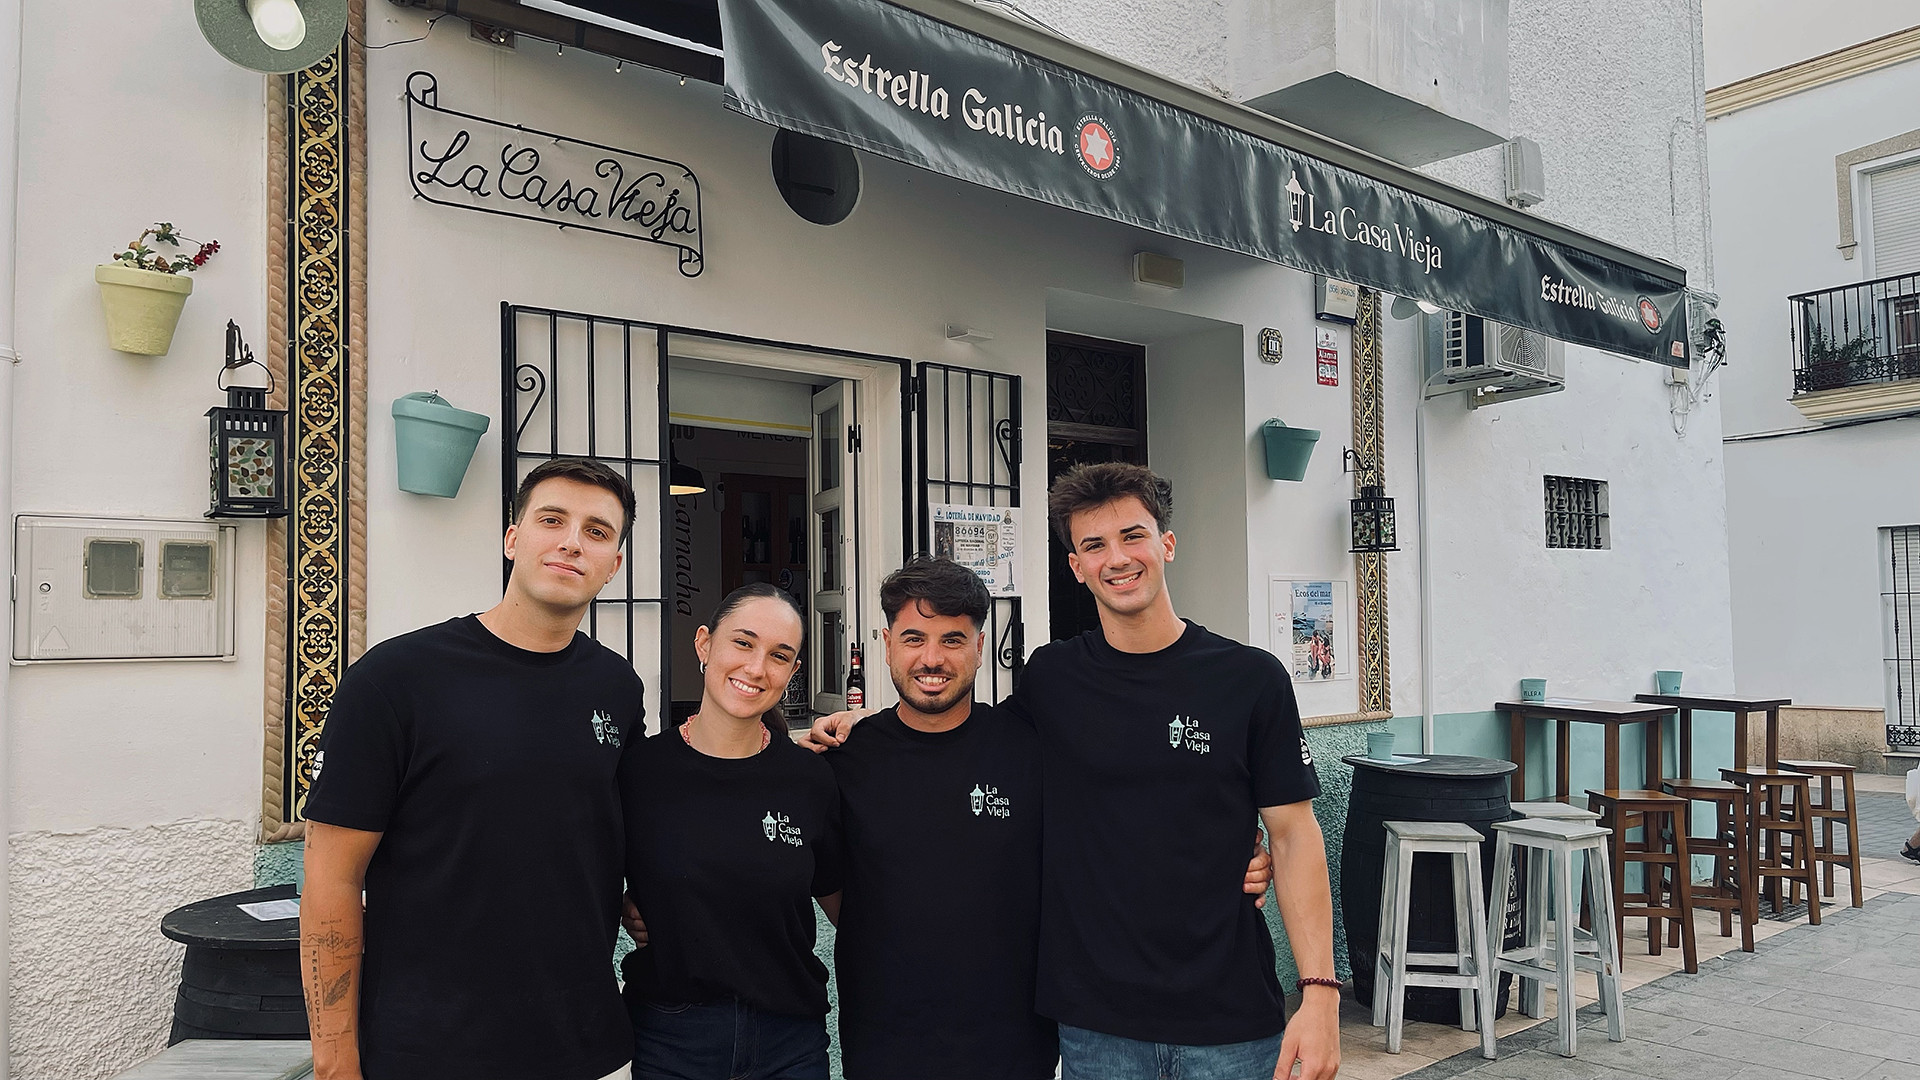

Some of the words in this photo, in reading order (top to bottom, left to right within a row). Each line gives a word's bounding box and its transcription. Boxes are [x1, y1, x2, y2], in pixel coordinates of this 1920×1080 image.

[820, 40, 950, 121] Estrella
[960, 87, 1065, 156] Galicia
[1076, 114, 1098, 131] ESTRELLA
[1098, 117, 1117, 143] GALICIA
[416, 130, 491, 197] La
[498, 143, 602, 219] Casa
[595, 158, 697, 241] Vieja
[1307, 193, 1338, 235] La
[1339, 206, 1393, 253] Casa
[1393, 222, 1443, 275] Vieja
[1540, 274, 1597, 311] Estrella
[1595, 290, 1639, 323] Galicia
[945, 509, 967, 521] LOTERÍA
[968, 512, 975, 521] DE
[975, 513, 1001, 522] NAVIDAD
[955, 526, 985, 536] 86694
[1294, 589, 1309, 598] Ecos
[1310, 590, 1320, 598] del
[601, 710, 612, 722] La
[1185, 715, 1199, 728] La
[604, 722, 620, 735] Casa
[1185, 727, 1211, 741] Casa
[1184, 738, 1211, 755] Vieja
[985, 784, 998, 795] La
[985, 794, 1010, 806] Casa
[777, 811, 790, 823] La
[986, 805, 1011, 819] Vieja
[778, 822, 802, 835] Casa
[779, 833, 804, 848] Vieja
